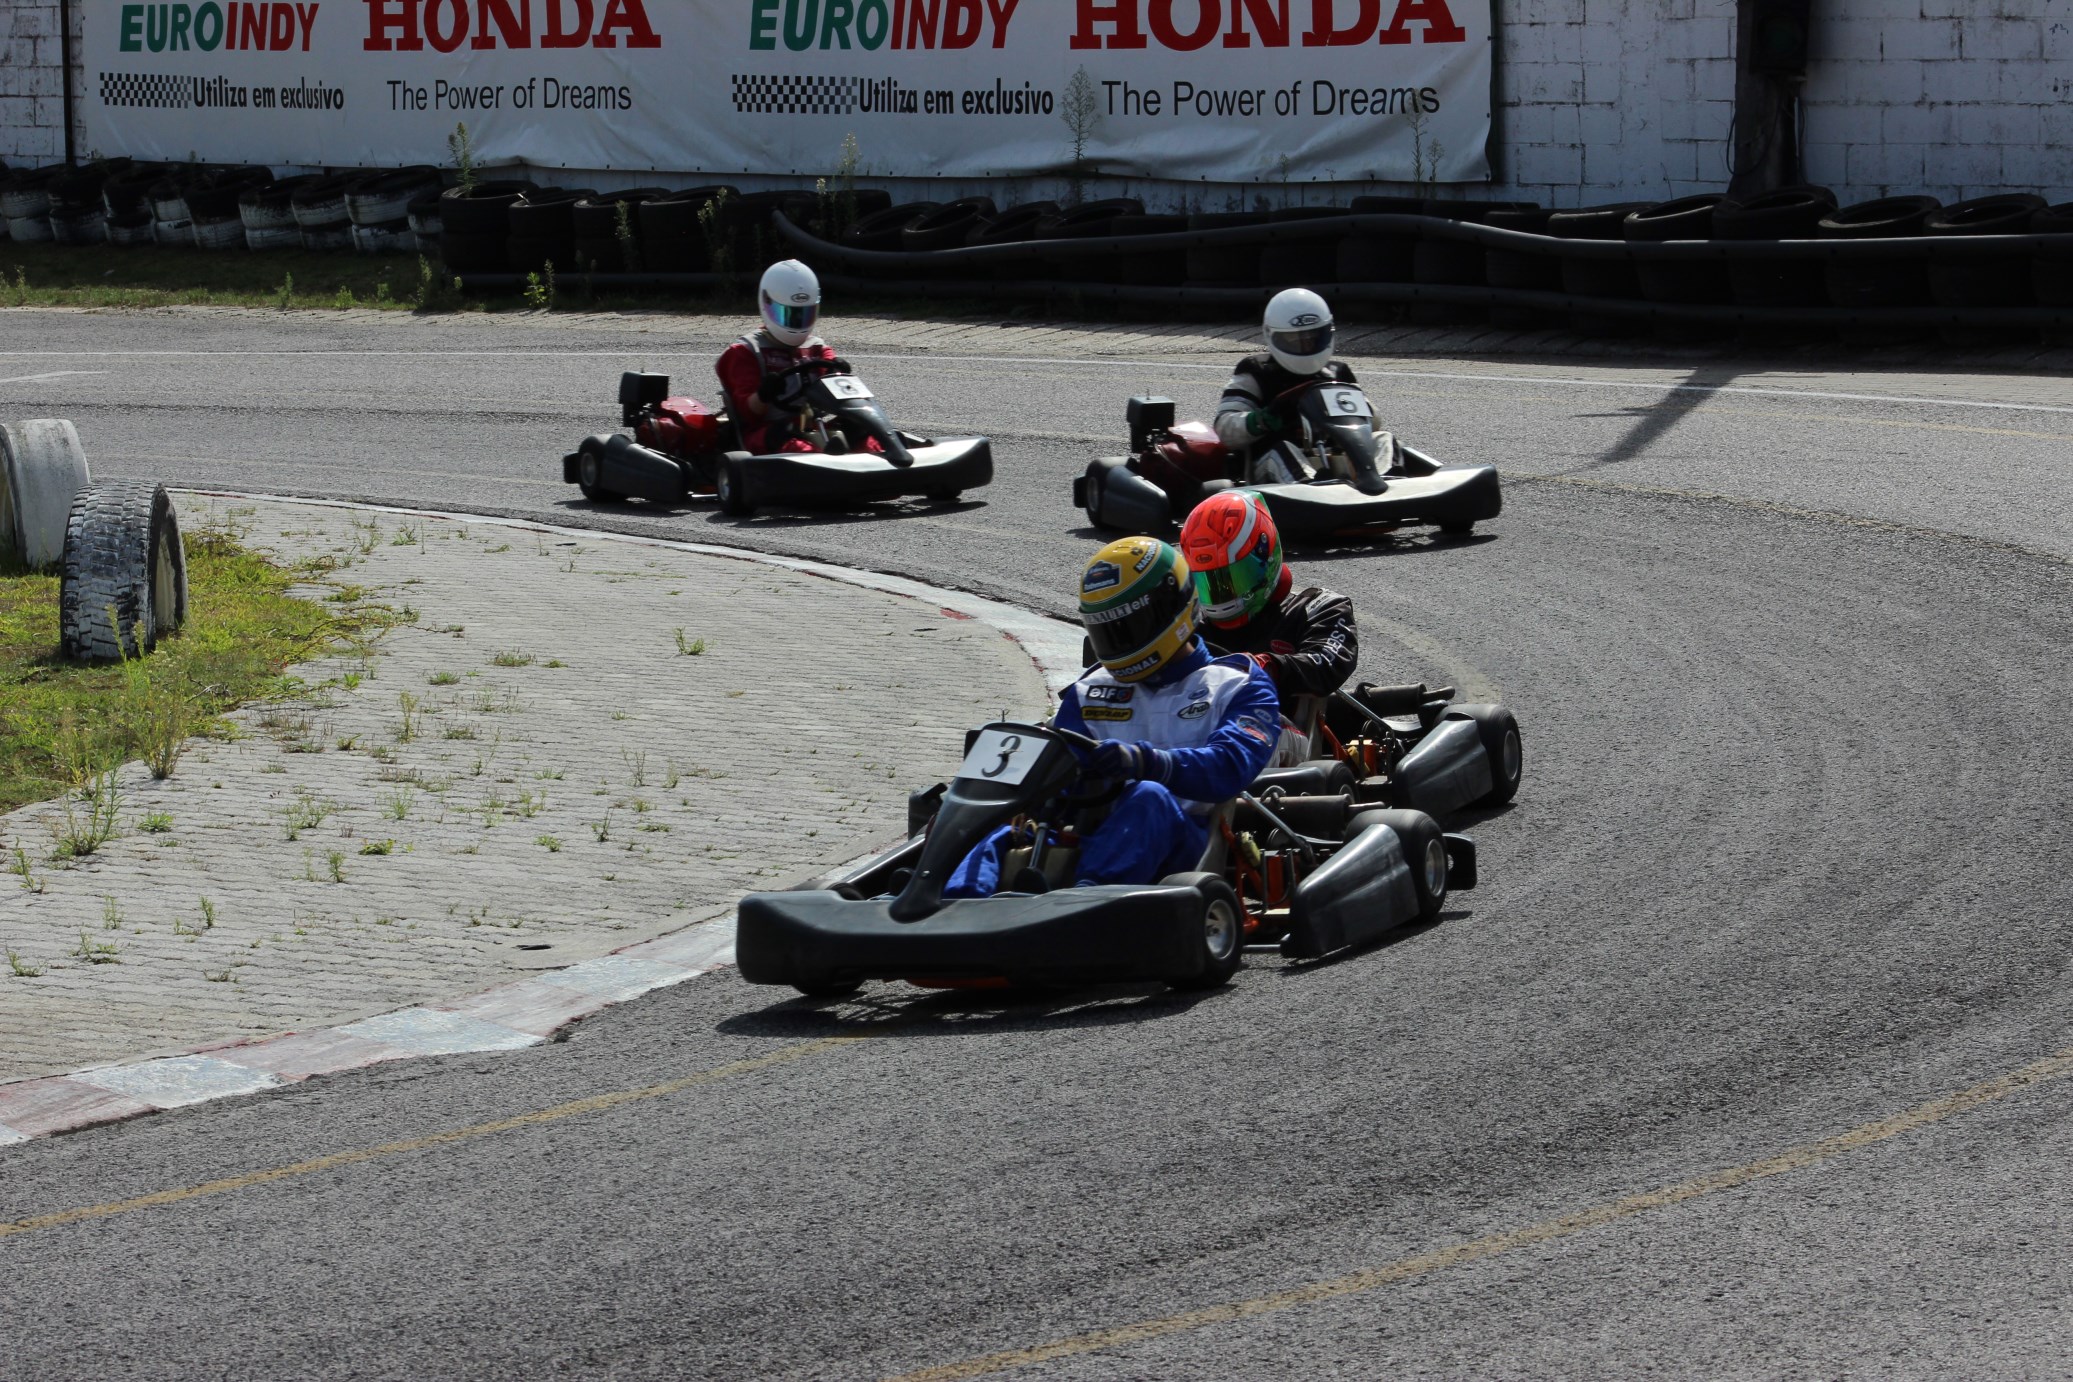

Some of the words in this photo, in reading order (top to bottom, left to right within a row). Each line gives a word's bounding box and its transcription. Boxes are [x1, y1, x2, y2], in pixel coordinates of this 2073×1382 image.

[119, 1, 320, 53] EUROINDY
[363, 0, 662, 53] HONDA
[749, 0, 1019, 51] EUROINDY
[1069, 0, 1466, 52] HONDA
[193, 75, 247, 108] Utiliza
[253, 86, 275, 109] em
[280, 76, 345, 110] exclusivo
[387, 80, 427, 110] The
[435, 79, 504, 110] Power
[512, 77, 536, 109] of
[543, 77, 632, 110] Dreams
[859, 77, 918, 113] Utiliza
[924, 89, 954, 114] em
[962, 78, 1054, 115] exclusivo
[1101, 80, 1161, 116] The
[1173, 81, 1265, 117] Power
[1275, 80, 1302, 116] of
[1312, 80, 1440, 116] Dreams
[1335, 391, 1358, 413] 6
[1088, 686, 1118, 699] elf
[981, 735, 1021, 777] 3
